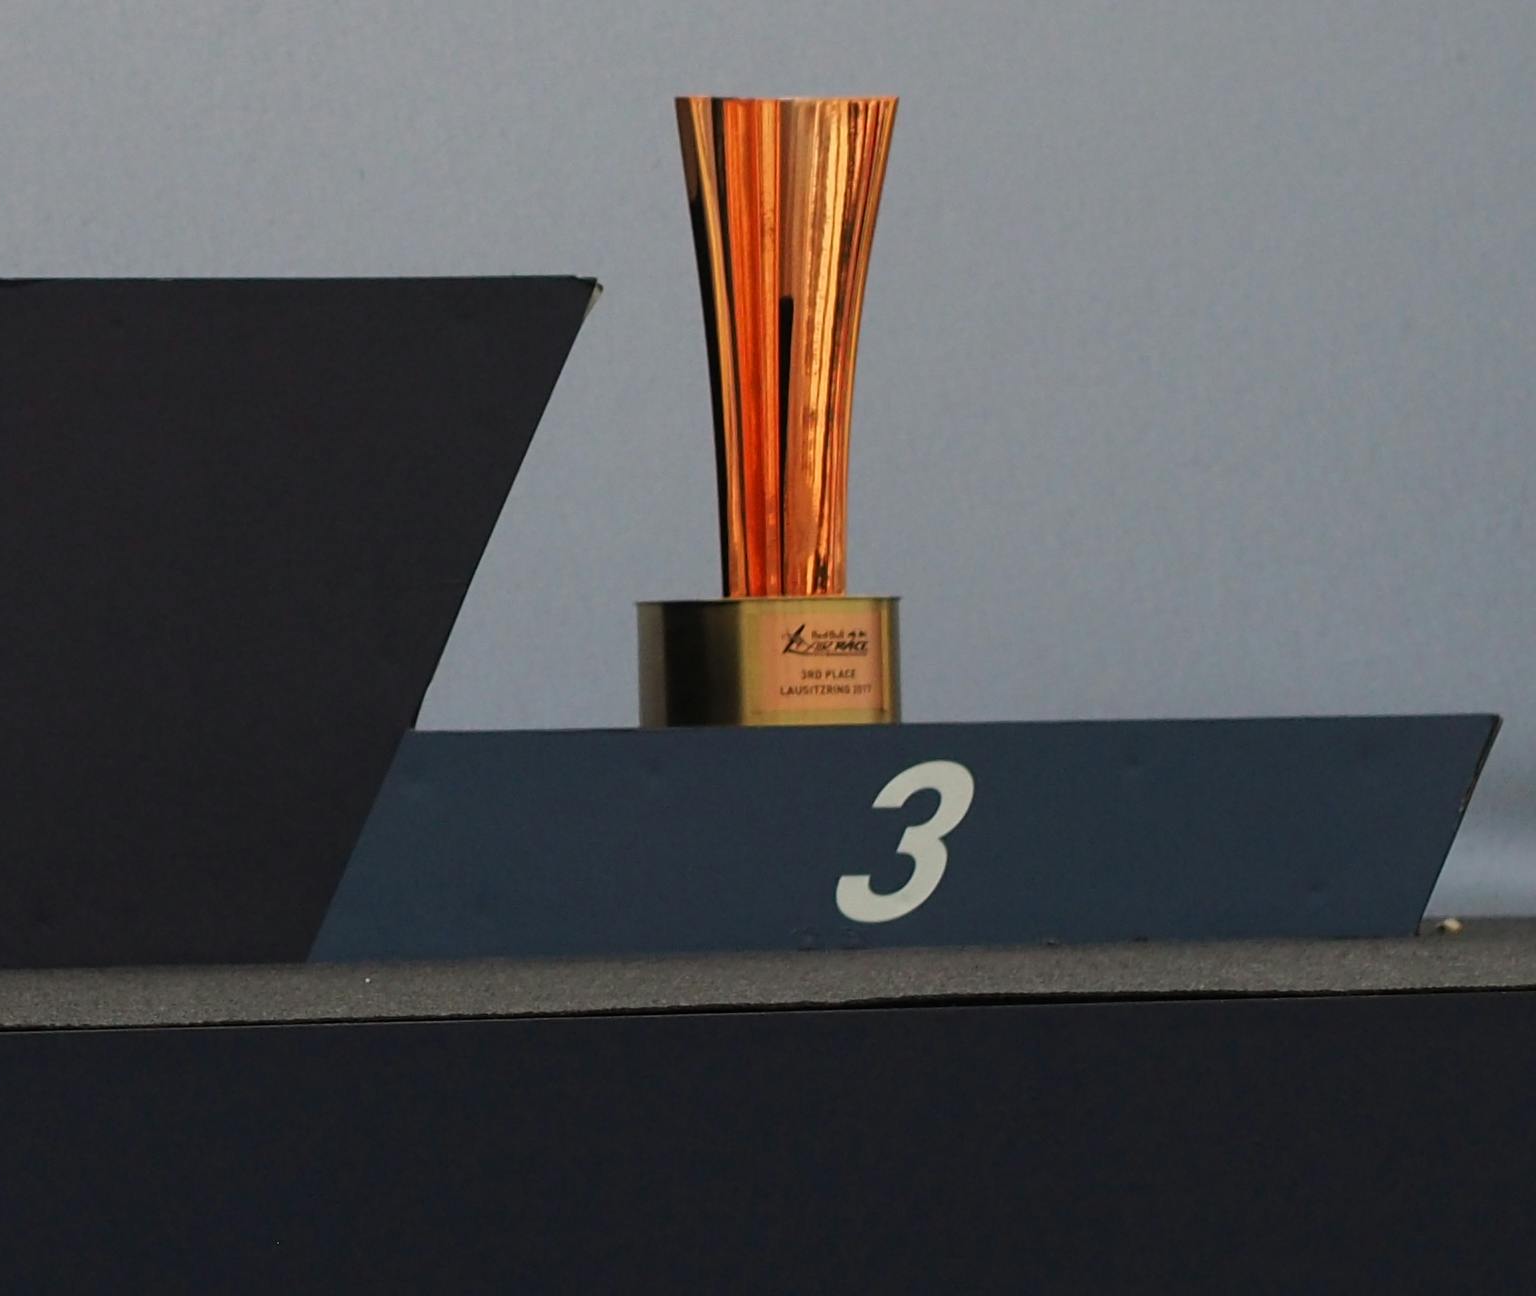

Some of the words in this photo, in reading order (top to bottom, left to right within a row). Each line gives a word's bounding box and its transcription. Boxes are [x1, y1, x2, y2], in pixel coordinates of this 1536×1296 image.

[801, 669, 822, 680] 3RD
[825, 669, 856, 680] PLACE
[835, 760, 975, 923] 3
